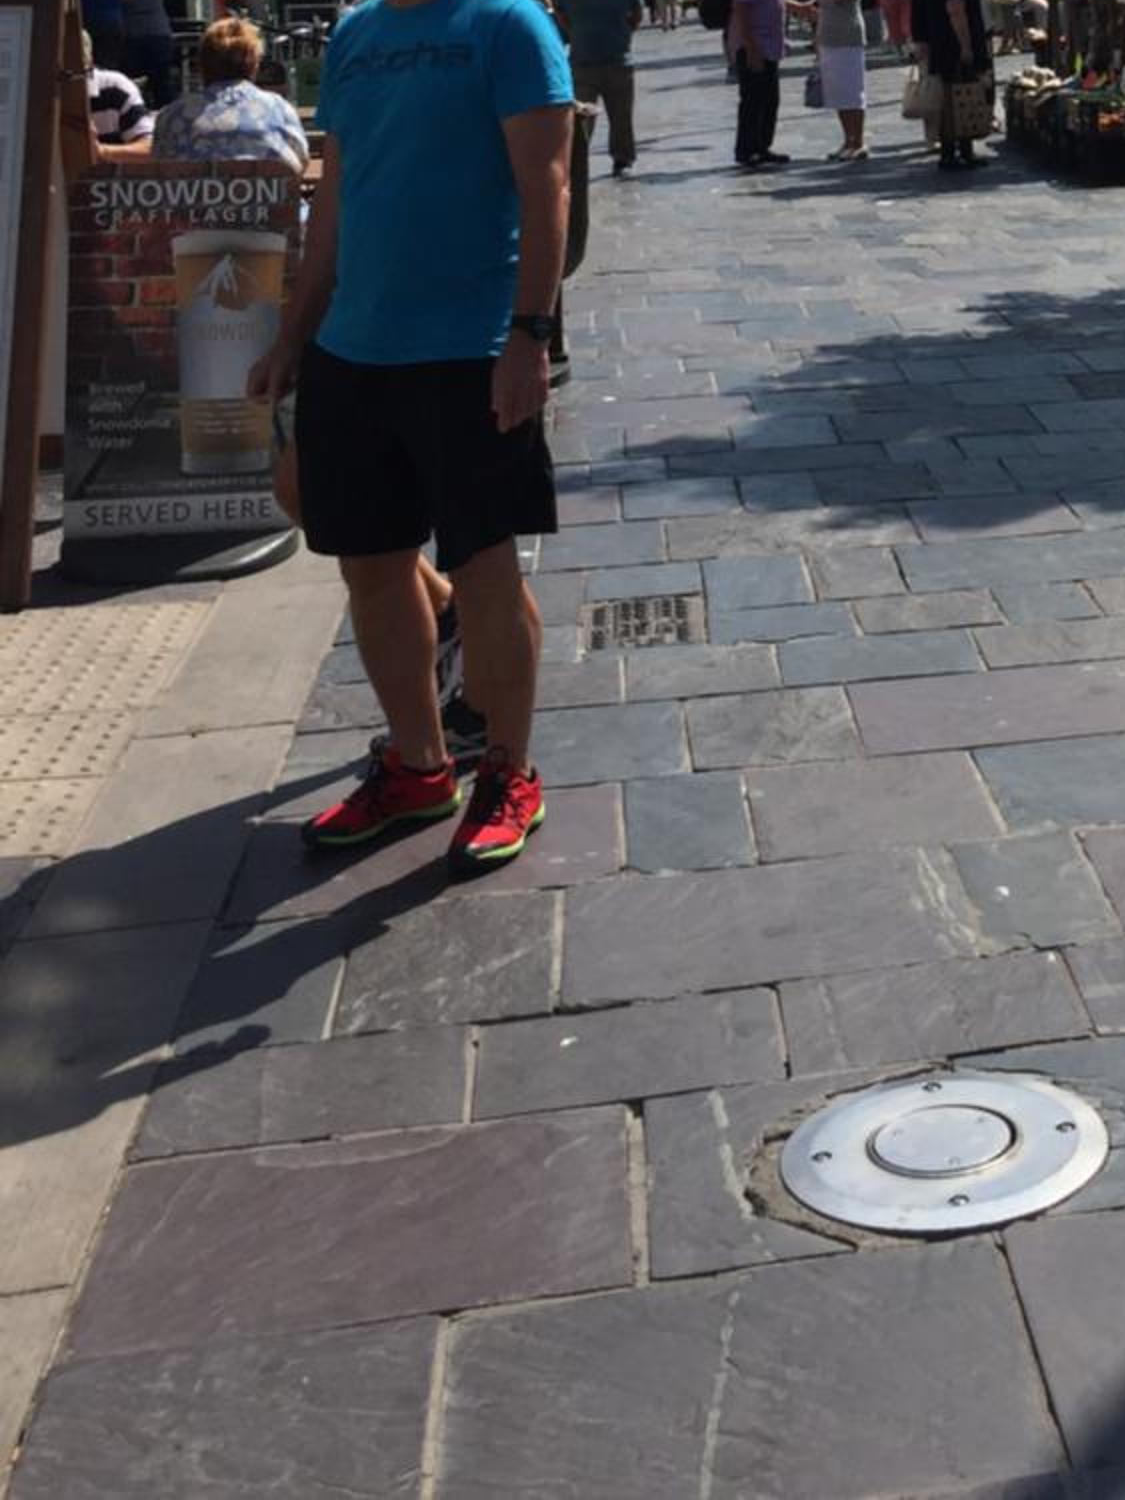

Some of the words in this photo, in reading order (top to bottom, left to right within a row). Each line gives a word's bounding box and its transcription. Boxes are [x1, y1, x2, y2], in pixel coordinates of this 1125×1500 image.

[90, 178, 277, 208] SNOWDON
[95, 208, 172, 227] CRAFT
[190, 205, 269, 223] LAGER
[84, 501, 191, 528] SERVED
[203, 498, 272, 520] HERE
